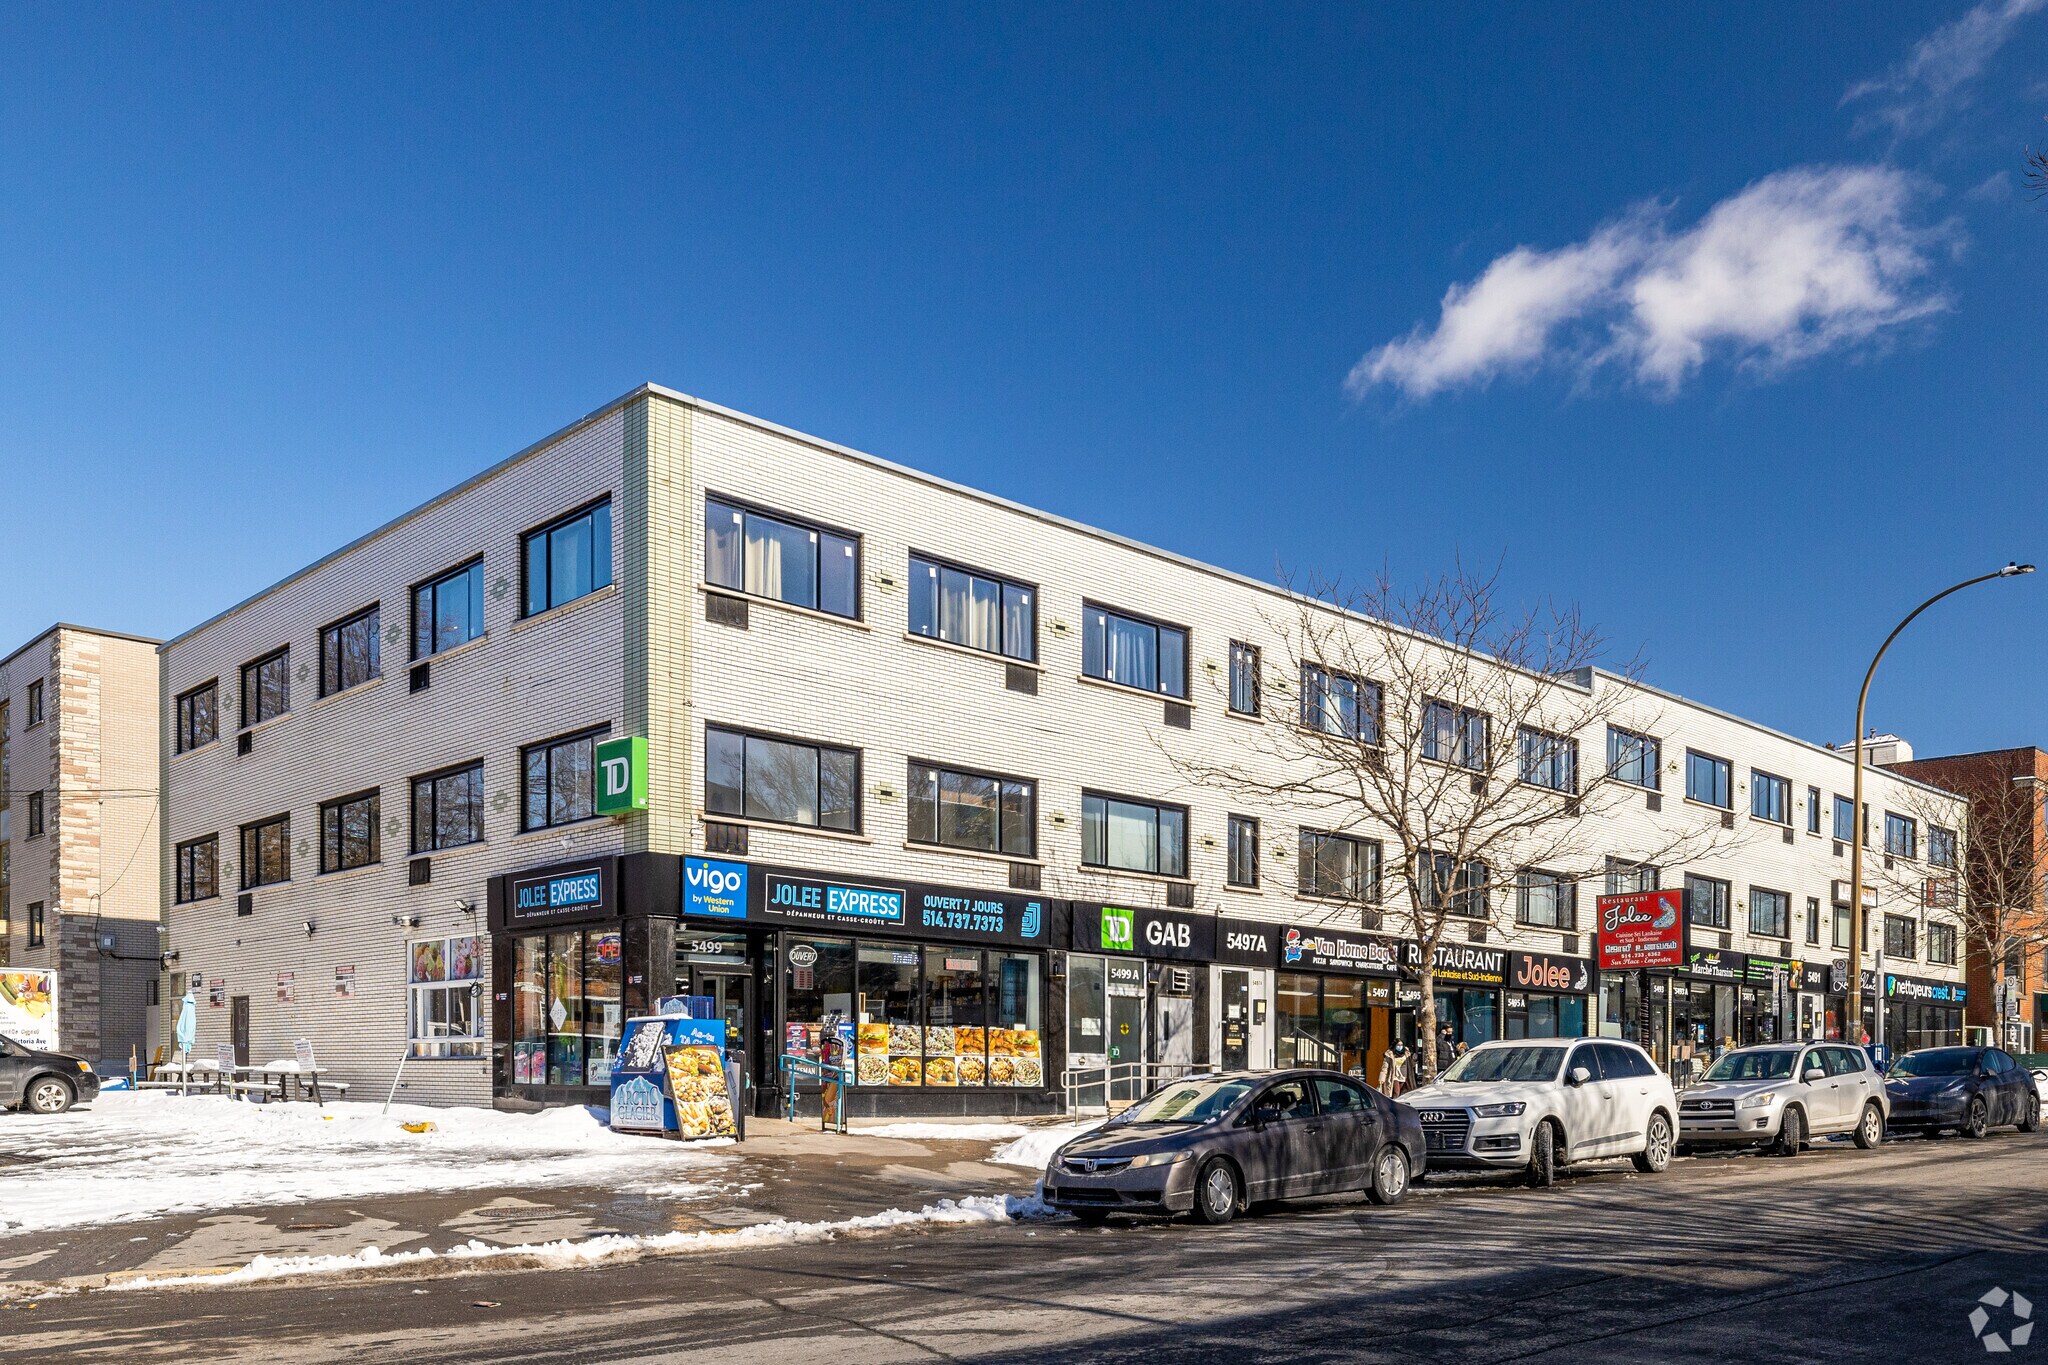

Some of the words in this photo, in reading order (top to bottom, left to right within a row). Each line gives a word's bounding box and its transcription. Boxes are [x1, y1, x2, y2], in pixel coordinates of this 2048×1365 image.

[601, 756, 629, 796] TD
[686, 862, 741, 894] vigo
[517, 885, 547, 908] JOLEE
[551, 877, 597, 906] EXPRESS
[692, 894, 703, 905] by
[703, 895, 735, 906] Western
[771, 884, 821, 909] JOLEE
[829, 889, 899, 916] EXPRESS
[1602, 895, 1649, 905] Restaurant
[708, 904, 730, 914] Union
[923, 895, 962, 910] OUVERT
[964, 899, 970, 911] 7
[972, 900, 1004, 914] JOURS
[526, 909, 550, 918] DÉPANNEUR
[786, 909, 826, 920] DÉPANNEUR
[837, 915, 885, 926] CASSE-CROÛTE
[922, 910, 1004, 933] 514.737.7373
[1604, 904, 1653, 931] Jolee
[1104, 915, 1130, 942] TD
[1146, 920, 1191, 948] GAB
[691, 941, 722, 954] 5499
[1226, 932, 1267, 952] 5497A
[1314, 936, 1336, 957] Van
[1336, 938, 1368, 960] Horne
[1369, 942, 1398, 965] Bagl
[790, 951, 817, 962] OUVERT
[1312, 957, 1327, 965] PIZZA
[1329, 958, 1353, 968] SANDWICH
[1111, 968, 1131, 979] 5499
[1133, 970, 1140, 980] A
[1462, 971, 1468, 980] et
[1517, 955, 1571, 989] Jolee
[1691, 963, 1713, 976] Marché
[1372, 987, 1389, 998] 5497
[1406, 990, 1421, 1000] 5495
[1896, 980, 1932, 1000] nettoyeurs
[618, 1086, 659, 1106] ARCTIC
[618, 1106, 658, 1121] GLACIER
